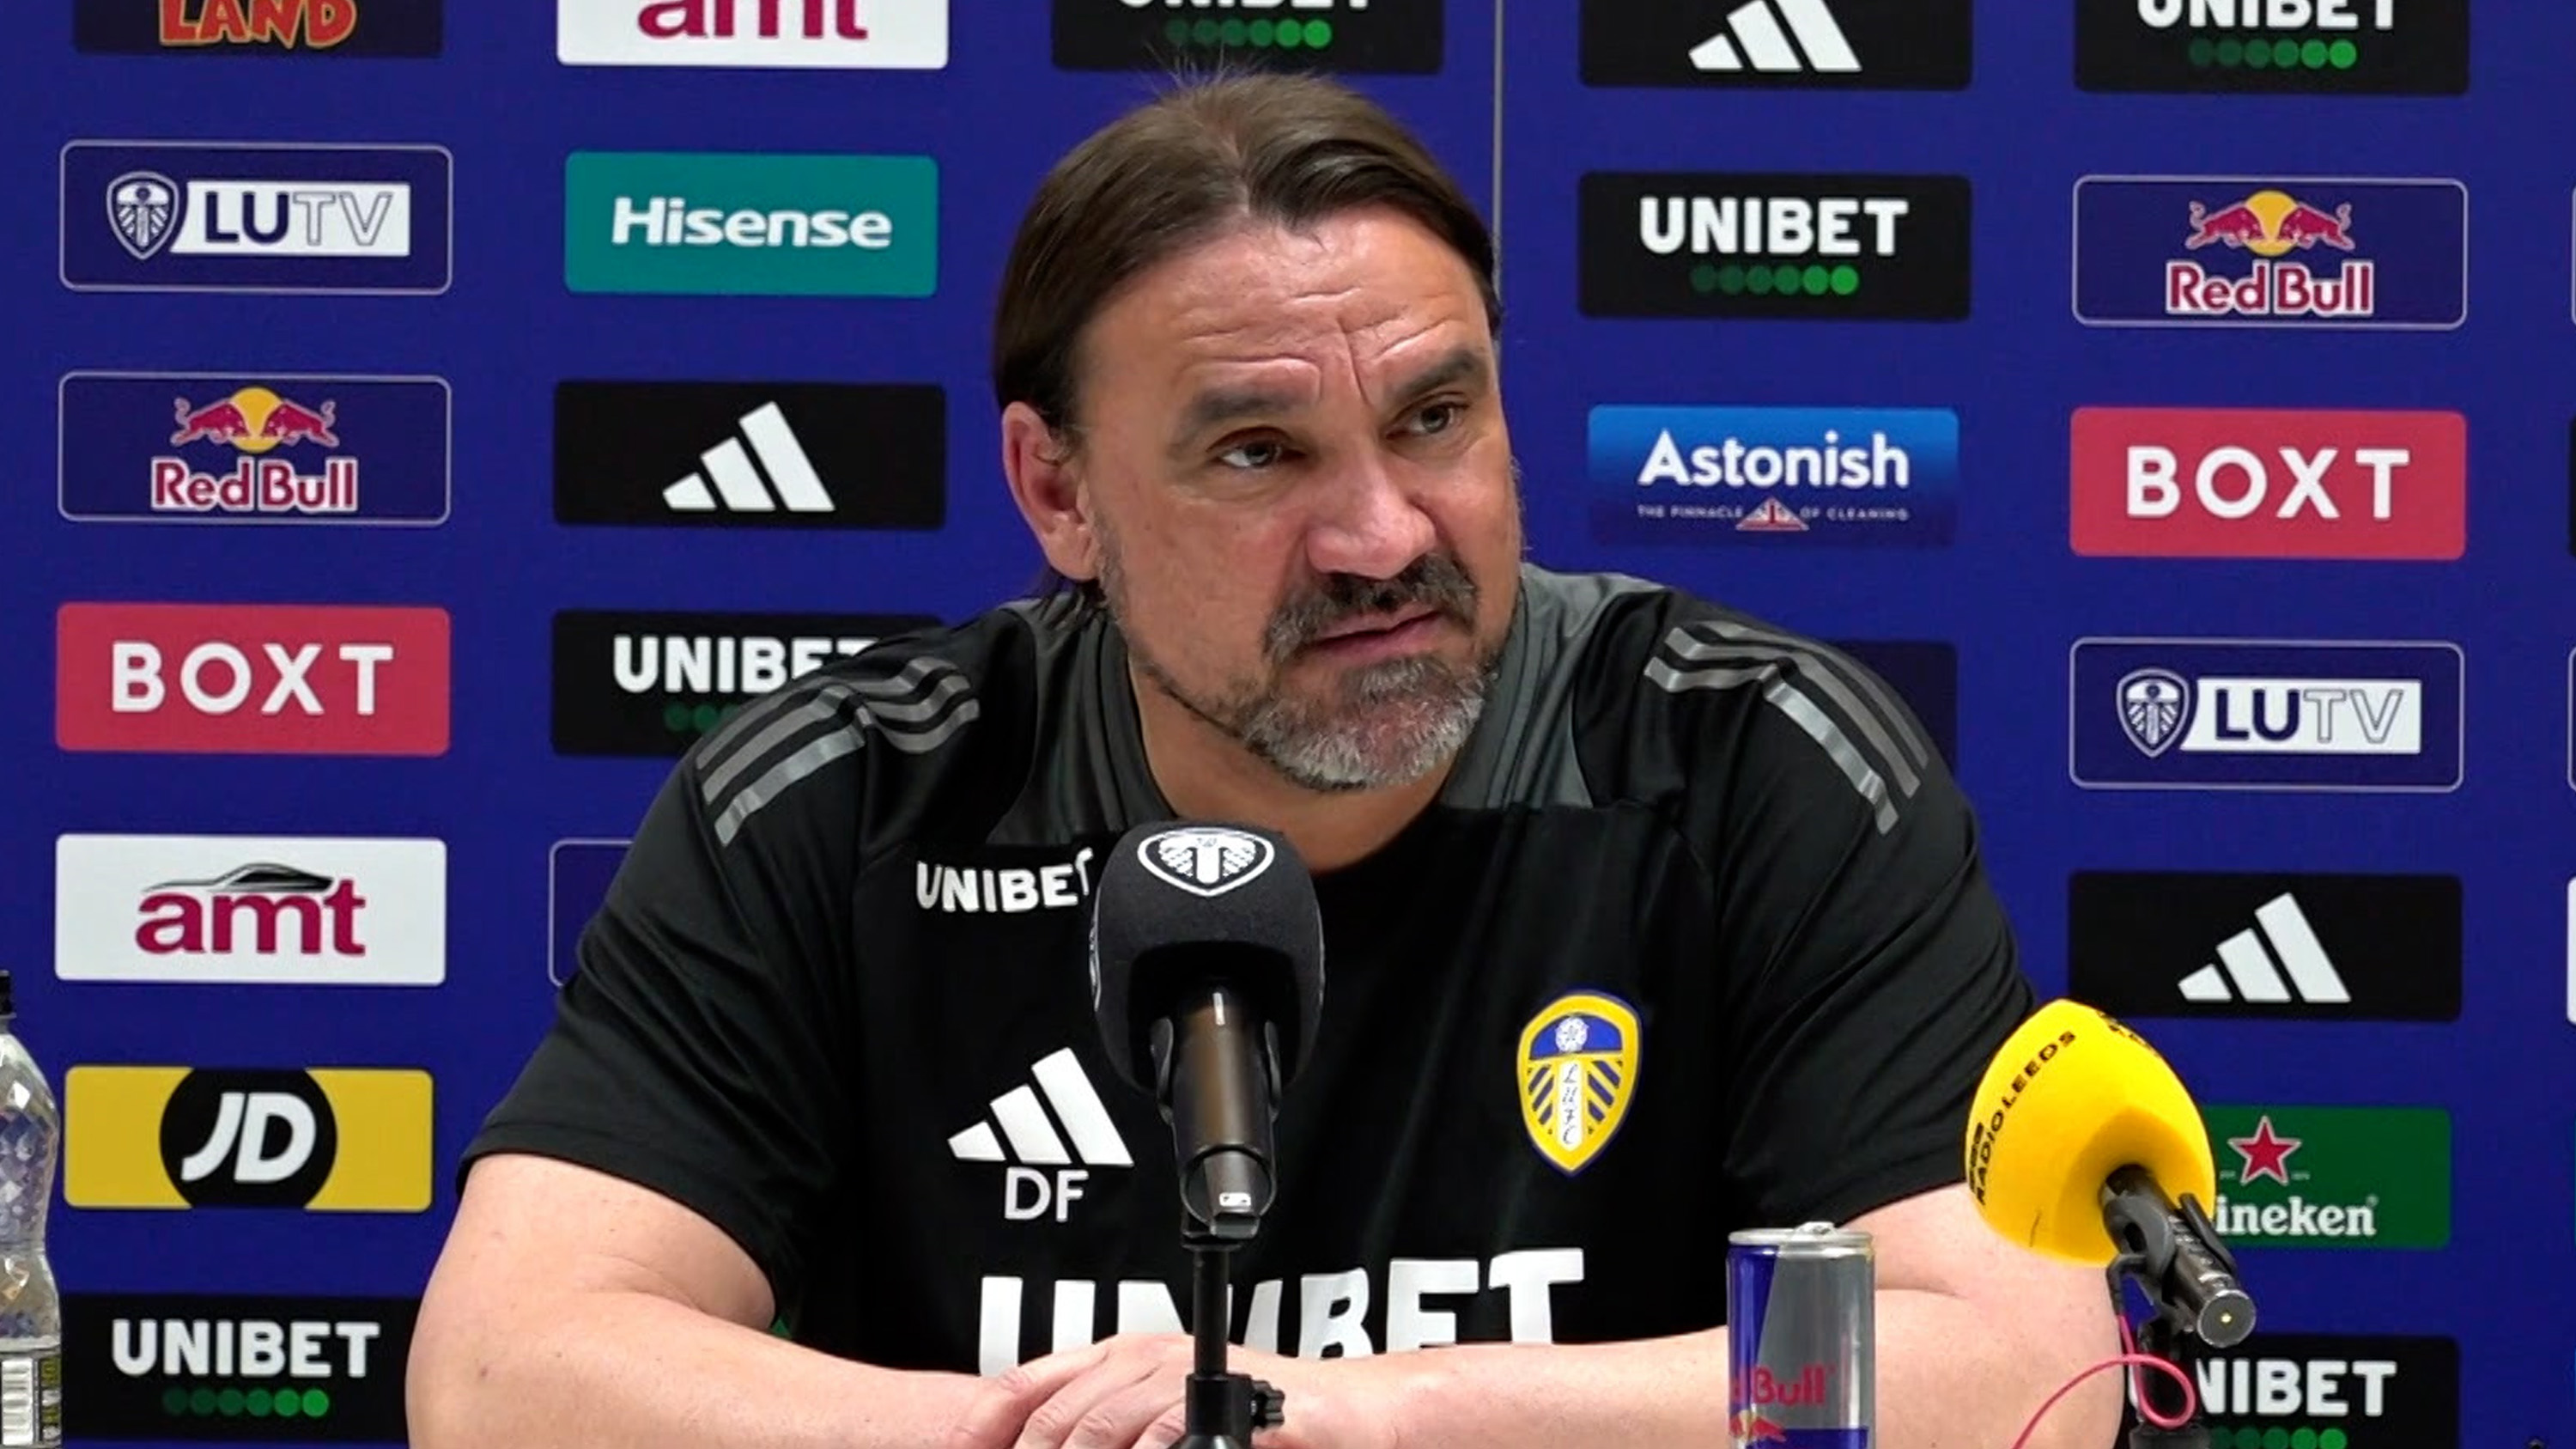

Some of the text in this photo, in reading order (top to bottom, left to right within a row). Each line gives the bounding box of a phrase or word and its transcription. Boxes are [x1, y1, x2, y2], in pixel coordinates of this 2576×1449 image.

[159, 0, 357, 49] LAND
[204, 190, 393, 247] LUTV
[611, 197, 893, 249] Hisense
[1639, 196, 1910, 257] UNIBET
[2166, 259, 2374, 317] Red Bull
[151, 457, 358, 513] Red Bull
[1638, 429, 1910, 487] Astonish
[2126, 445, 2410, 521] BOXT
[112, 641, 394, 715] BOXT
[2214, 688, 2404, 745] LUTV
[135, 878, 367, 957] amt
[180, 1092, 317, 1183] JD
[1004, 1166, 1090, 1223] DF
[2215, 1192, 2378, 1237] ineken
[112, 1318, 380, 1379] UNIBET
[1753, 1363, 1826, 1406] Bull
[2129, 1357, 2398, 1417] NIBET
